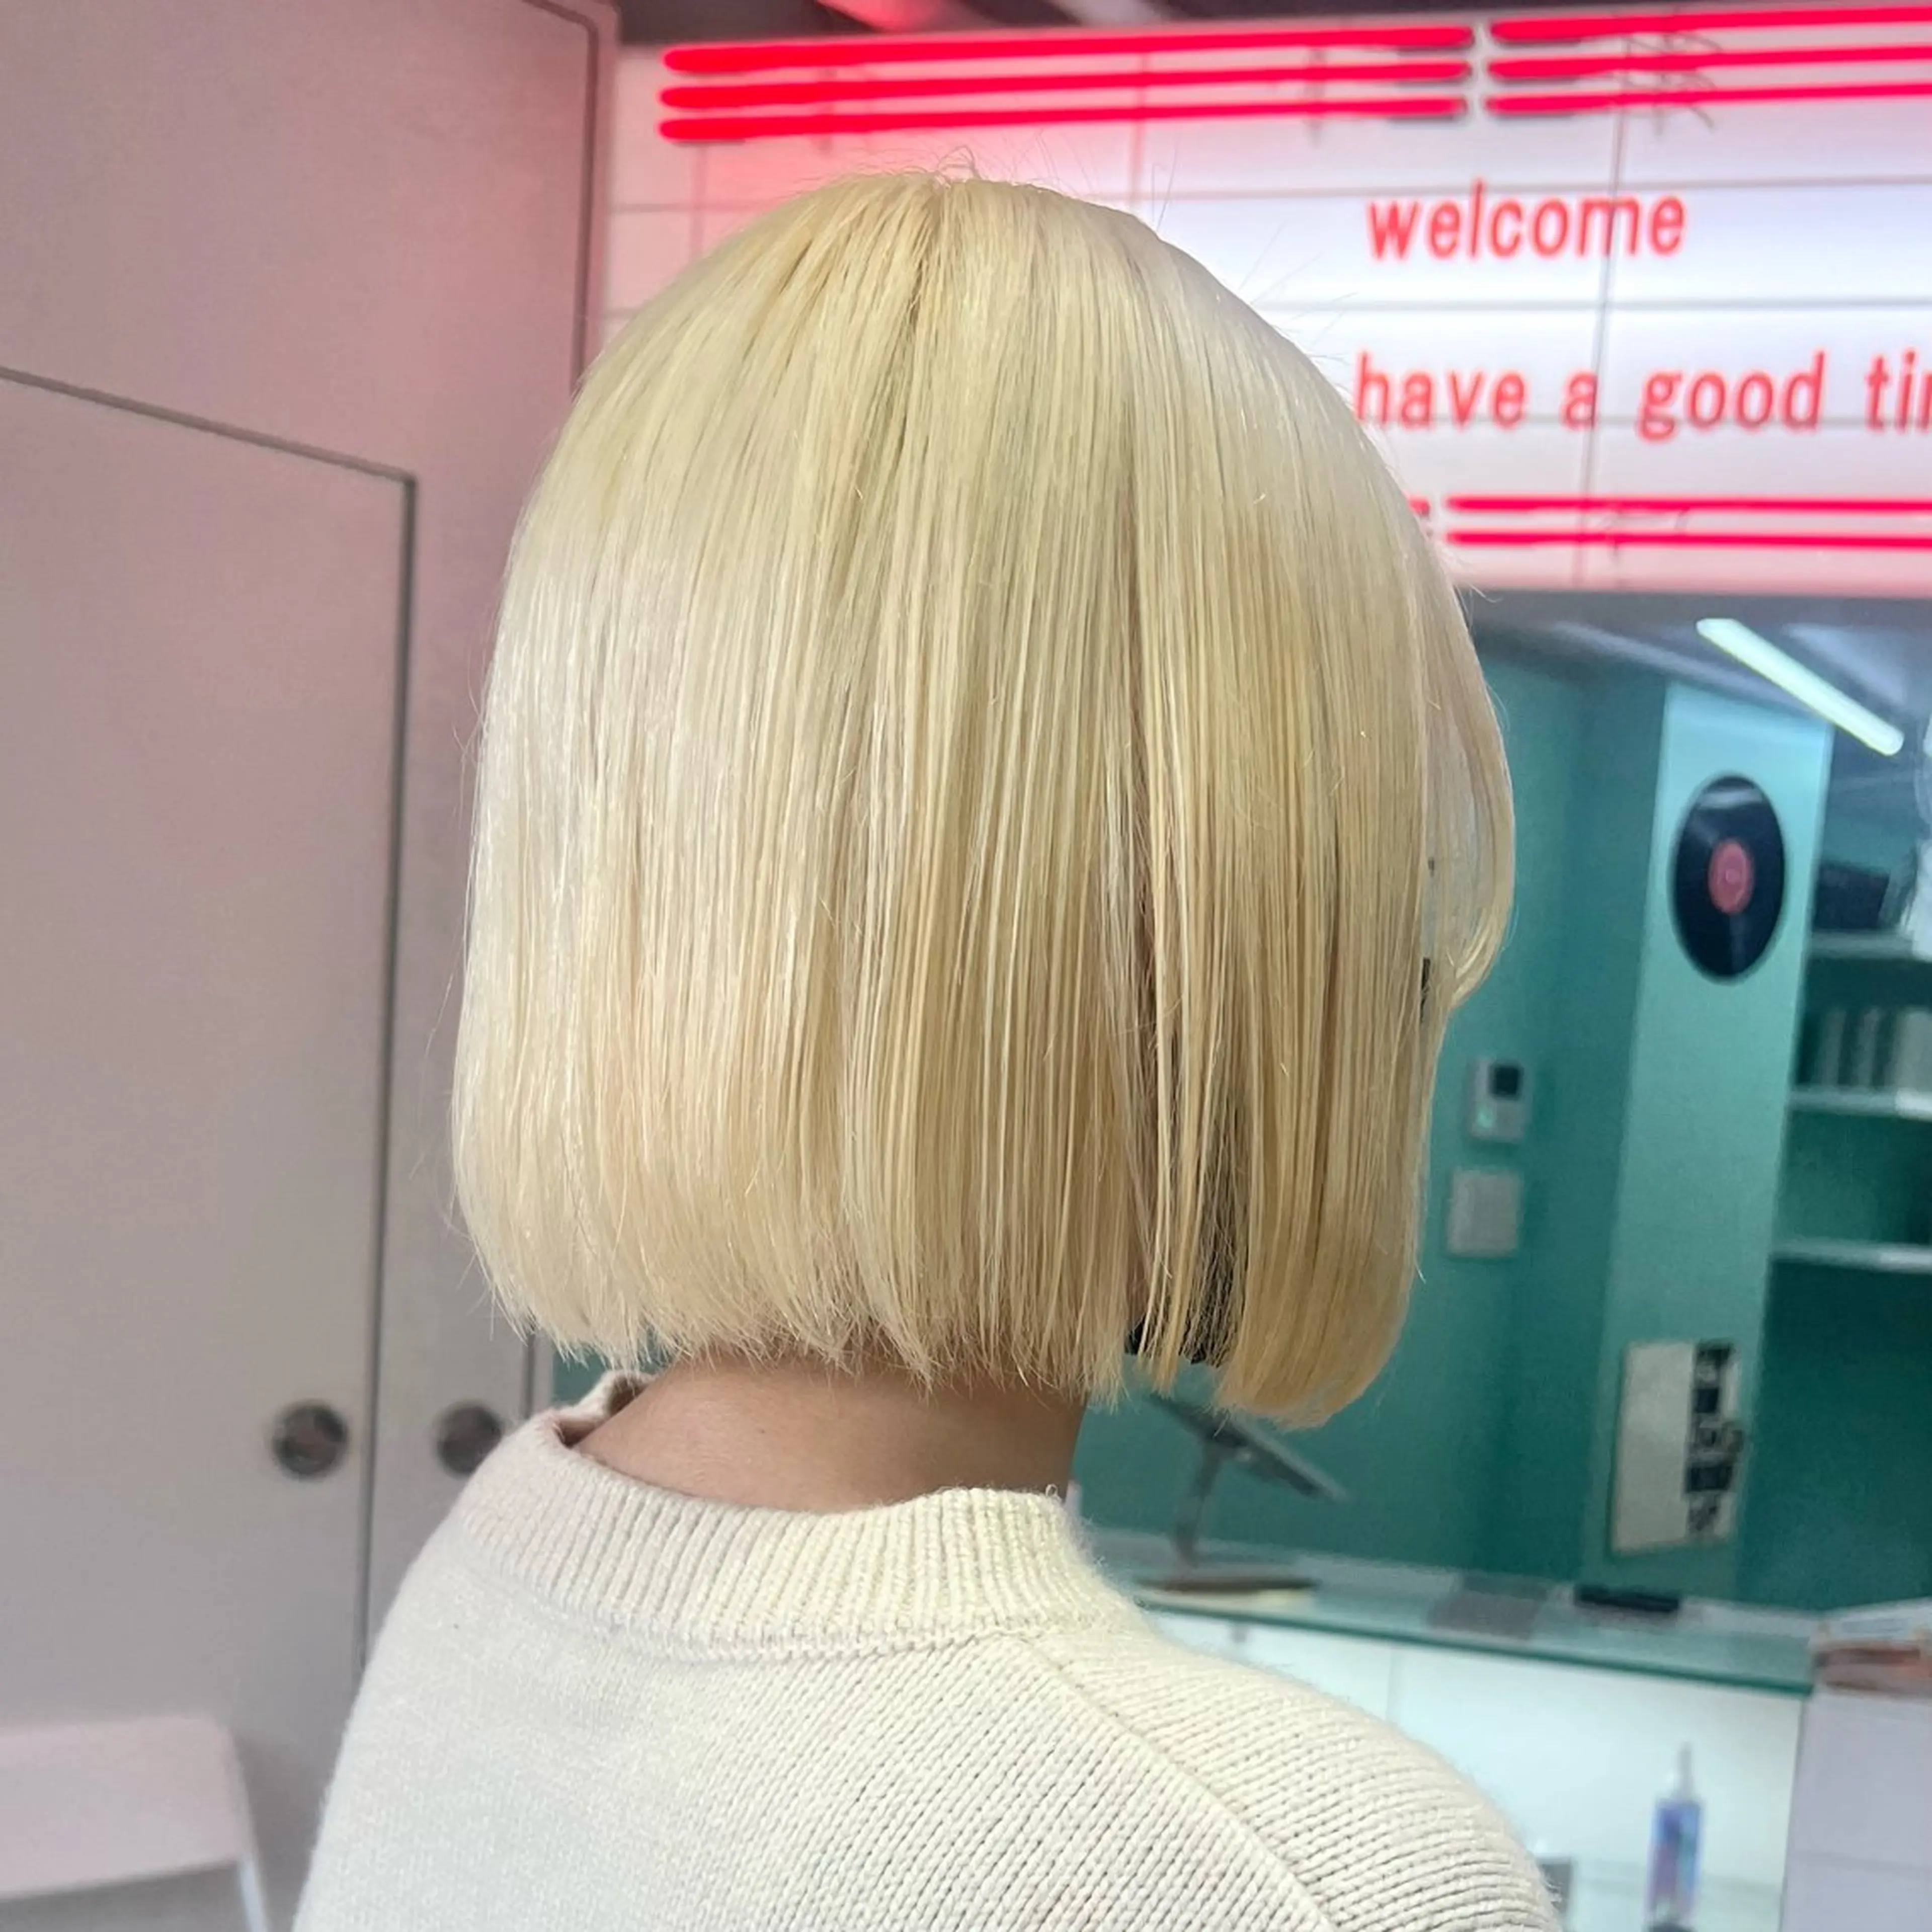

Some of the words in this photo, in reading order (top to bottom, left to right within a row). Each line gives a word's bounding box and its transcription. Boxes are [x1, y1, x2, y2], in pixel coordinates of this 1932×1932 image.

[1366, 179, 1686, 262] welcome
[1353, 351, 1526, 431] have
[1560, 371, 1599, 430] a
[1636, 351, 1825, 443] good
[1865, 350, 1932, 434] ti
